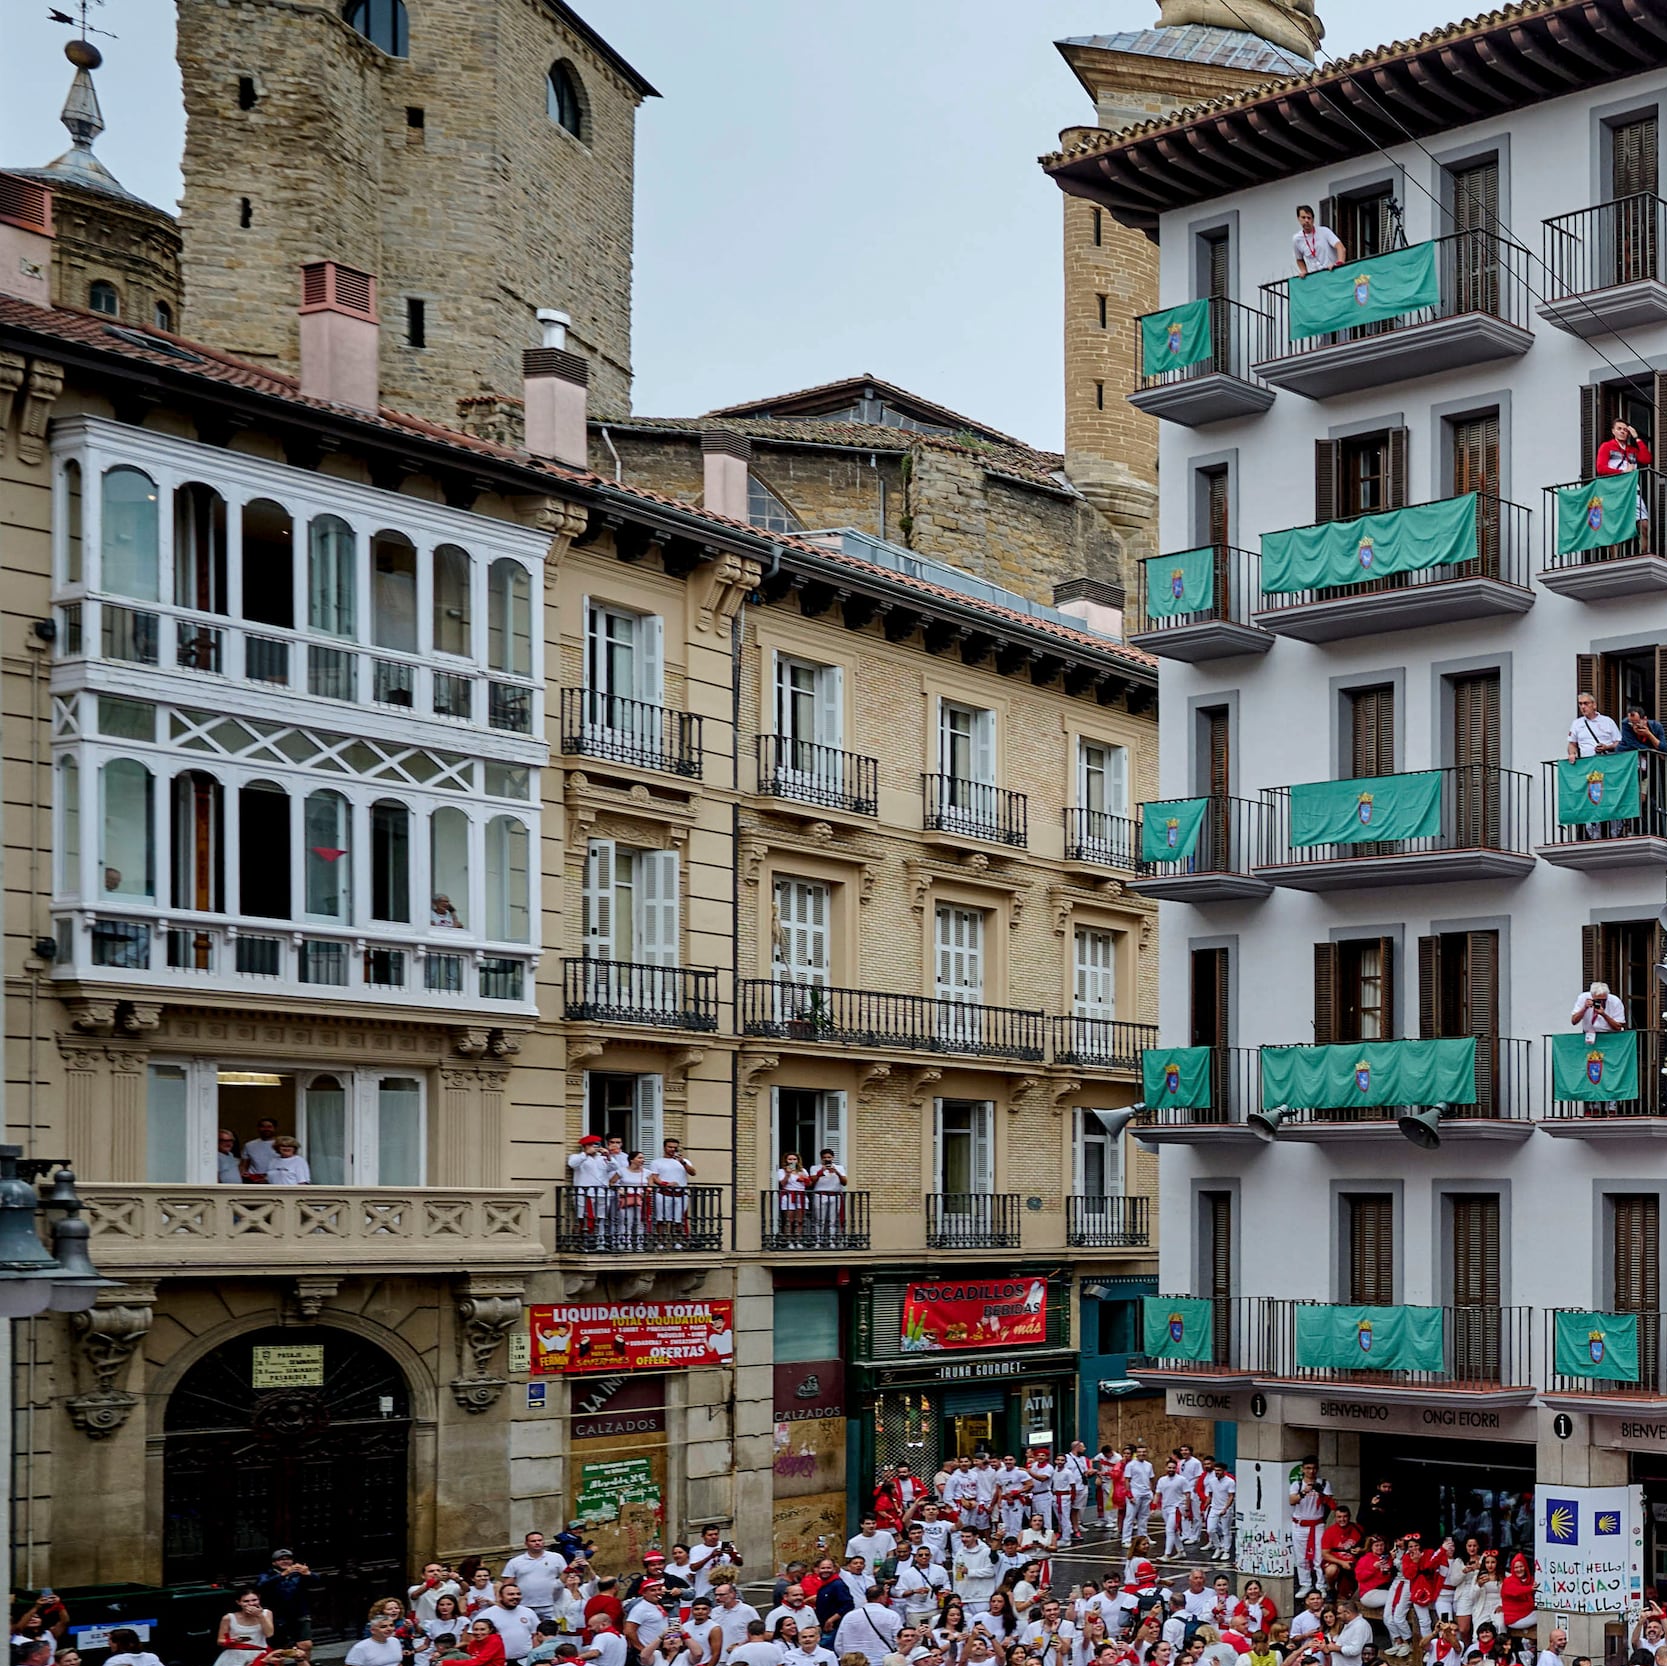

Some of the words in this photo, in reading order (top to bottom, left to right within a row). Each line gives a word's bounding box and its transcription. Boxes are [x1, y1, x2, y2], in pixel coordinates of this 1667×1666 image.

[913, 1284, 1025, 1302] BOCADILLOS
[553, 1302, 659, 1324] LIQUIDACIÓN
[664, 1303, 712, 1319] TOTAL
[983, 1302, 1041, 1318] BEBIDAS
[611, 1316, 642, 1327] TOTAL
[645, 1313, 713, 1326] LIQUIDATION
[1013, 1317, 1042, 1335] más
[650, 1345, 706, 1358] OFERTAS
[636, 1356, 671, 1366] OFFERS
[578, 1393, 607, 1414] LA
[1024, 1395, 1053, 1411] ATM
[1176, 1392, 1231, 1409] WELCOME
[774, 1406, 841, 1422] CALZADOS
[1320, 1402, 1389, 1420] BIENVENIDO
[1422, 1409, 1456, 1426] ONGI
[1458, 1412, 1500, 1429] ETORRI
[575, 1418, 658, 1436] CALZADOS
[1586, 1561, 1626, 1574] HELLO!
[1581, 1574, 1627, 1595] CIAO!
